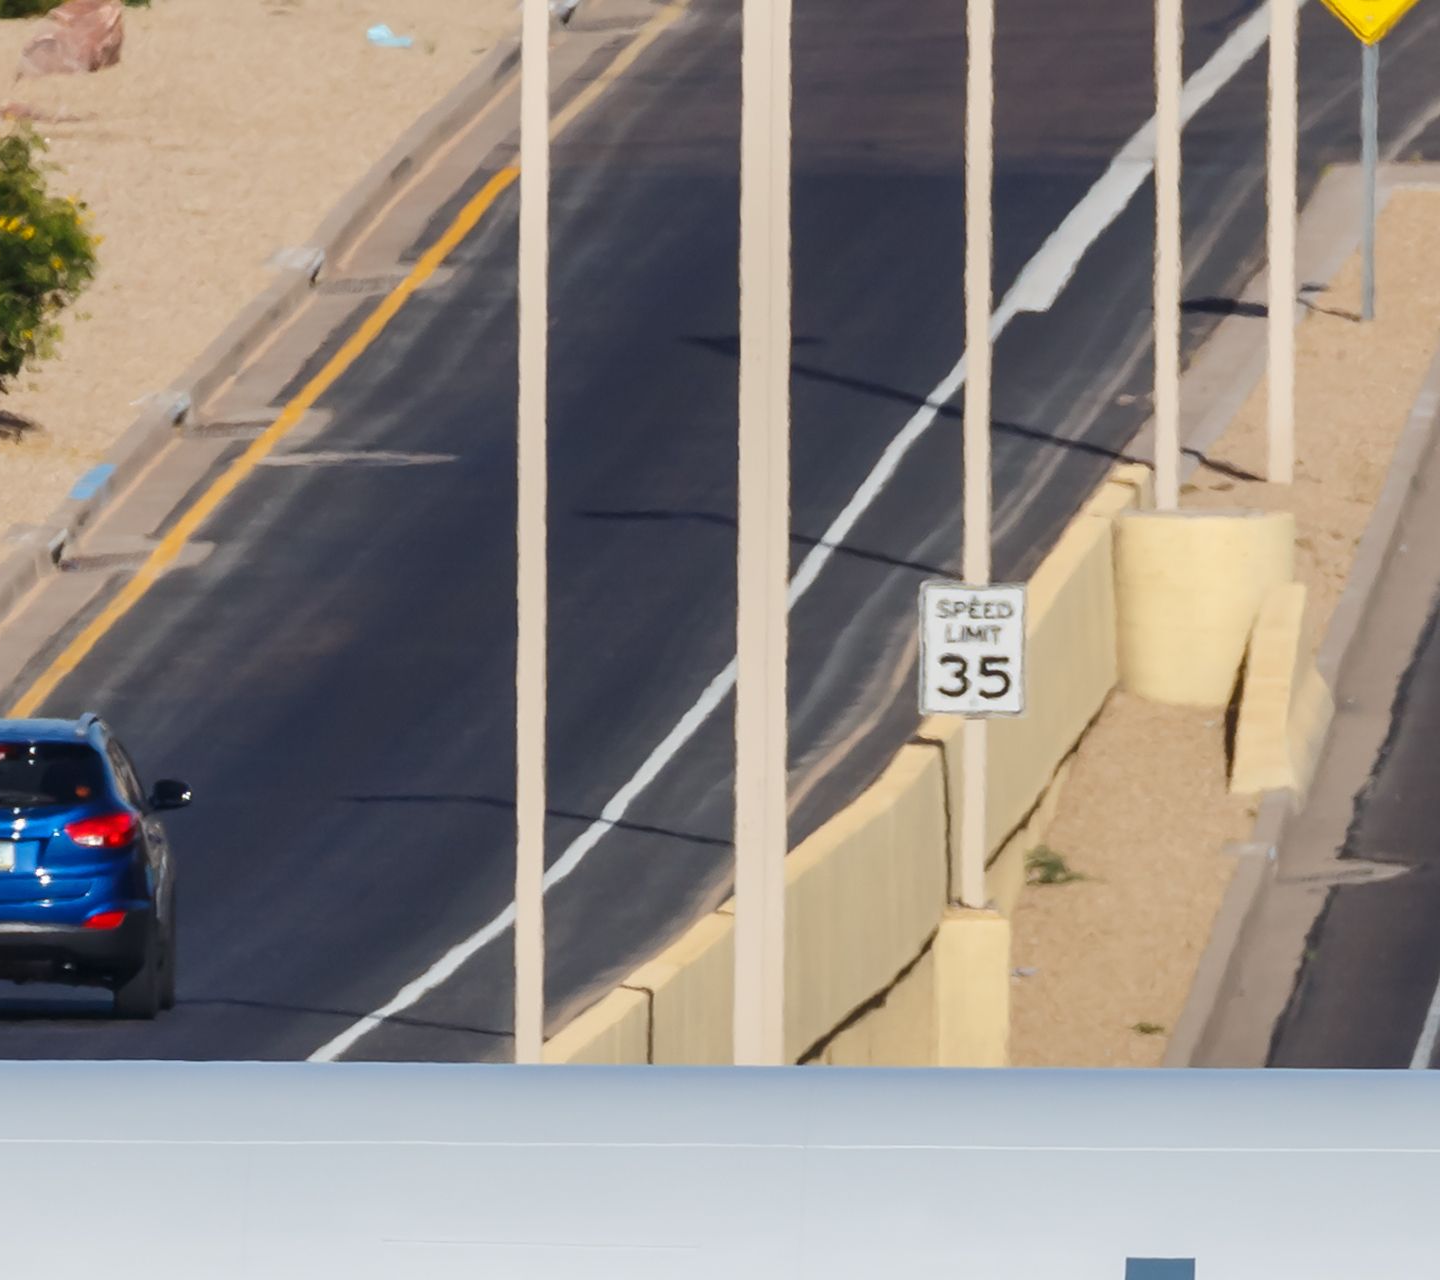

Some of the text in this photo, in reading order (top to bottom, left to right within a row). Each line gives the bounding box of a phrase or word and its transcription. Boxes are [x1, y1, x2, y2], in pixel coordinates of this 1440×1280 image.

[936, 598, 1013, 619] SPEED
[945, 624, 1001, 643] LIMIT
[937, 653, 1010, 698] 35
